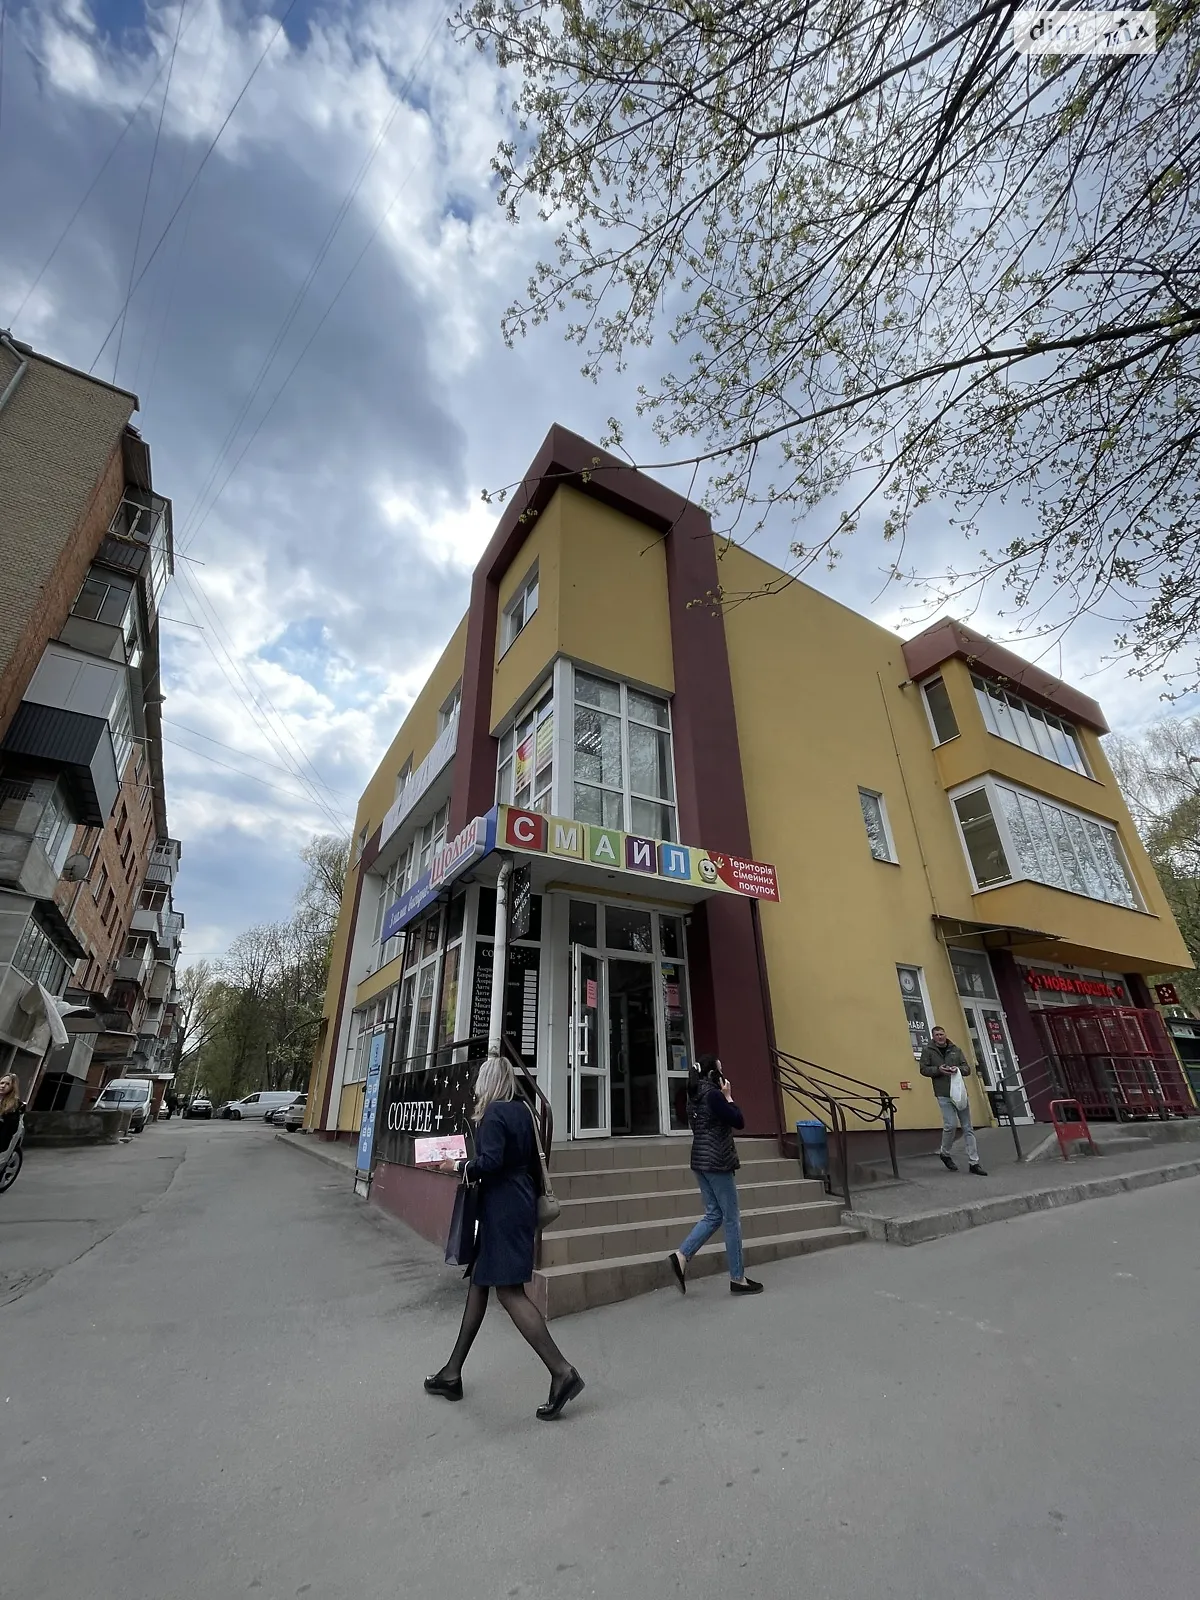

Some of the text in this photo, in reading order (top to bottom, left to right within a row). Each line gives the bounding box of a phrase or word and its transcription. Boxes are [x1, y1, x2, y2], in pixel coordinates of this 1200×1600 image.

[513, 816, 686, 874] СМАЙЛ
[729, 857, 773, 875] Територія
[733, 869, 774, 885] сімейних
[739, 881, 776, 896] покупок
[1041, 975, 1114, 998] НОВА ПОШТА
[387, 1101, 443, 1132] COFFEE+
